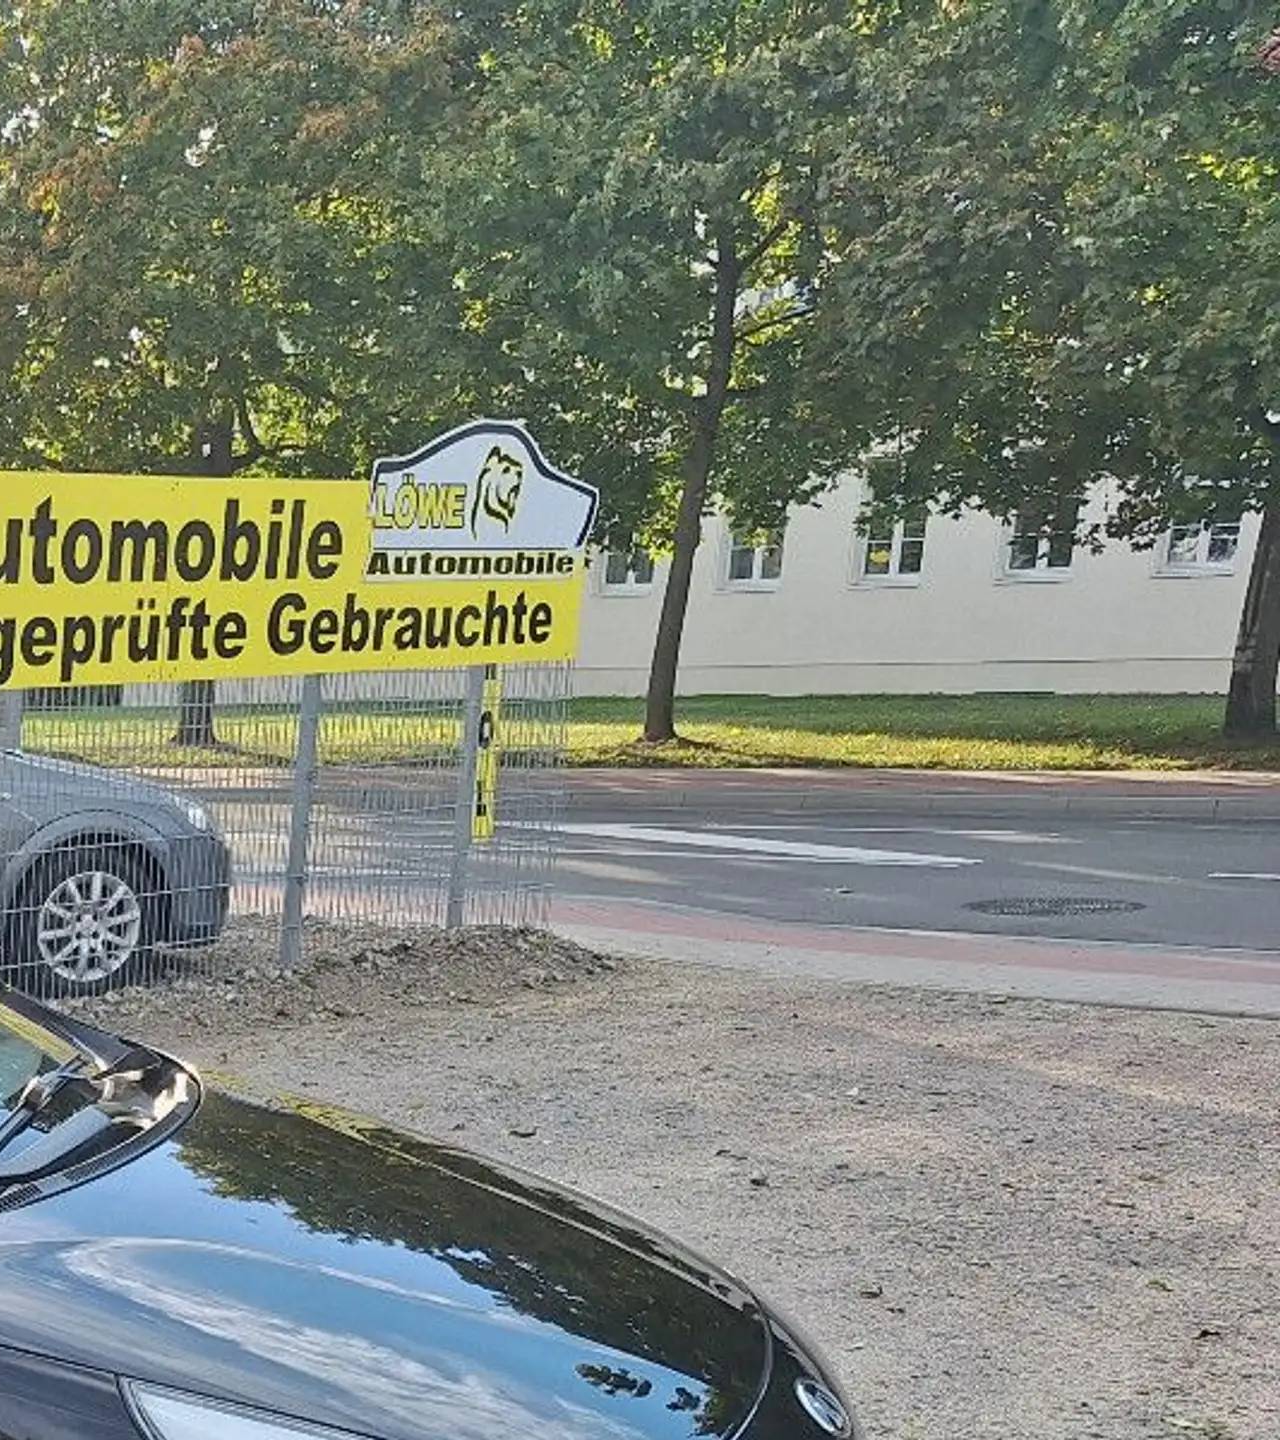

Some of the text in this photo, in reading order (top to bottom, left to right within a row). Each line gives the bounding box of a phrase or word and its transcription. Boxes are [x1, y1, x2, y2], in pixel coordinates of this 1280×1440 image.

[372, 473, 468, 530] LÖWE
[366, 551, 575, 576] Automobile
[267, 591, 553, 656] Gebrauchte
